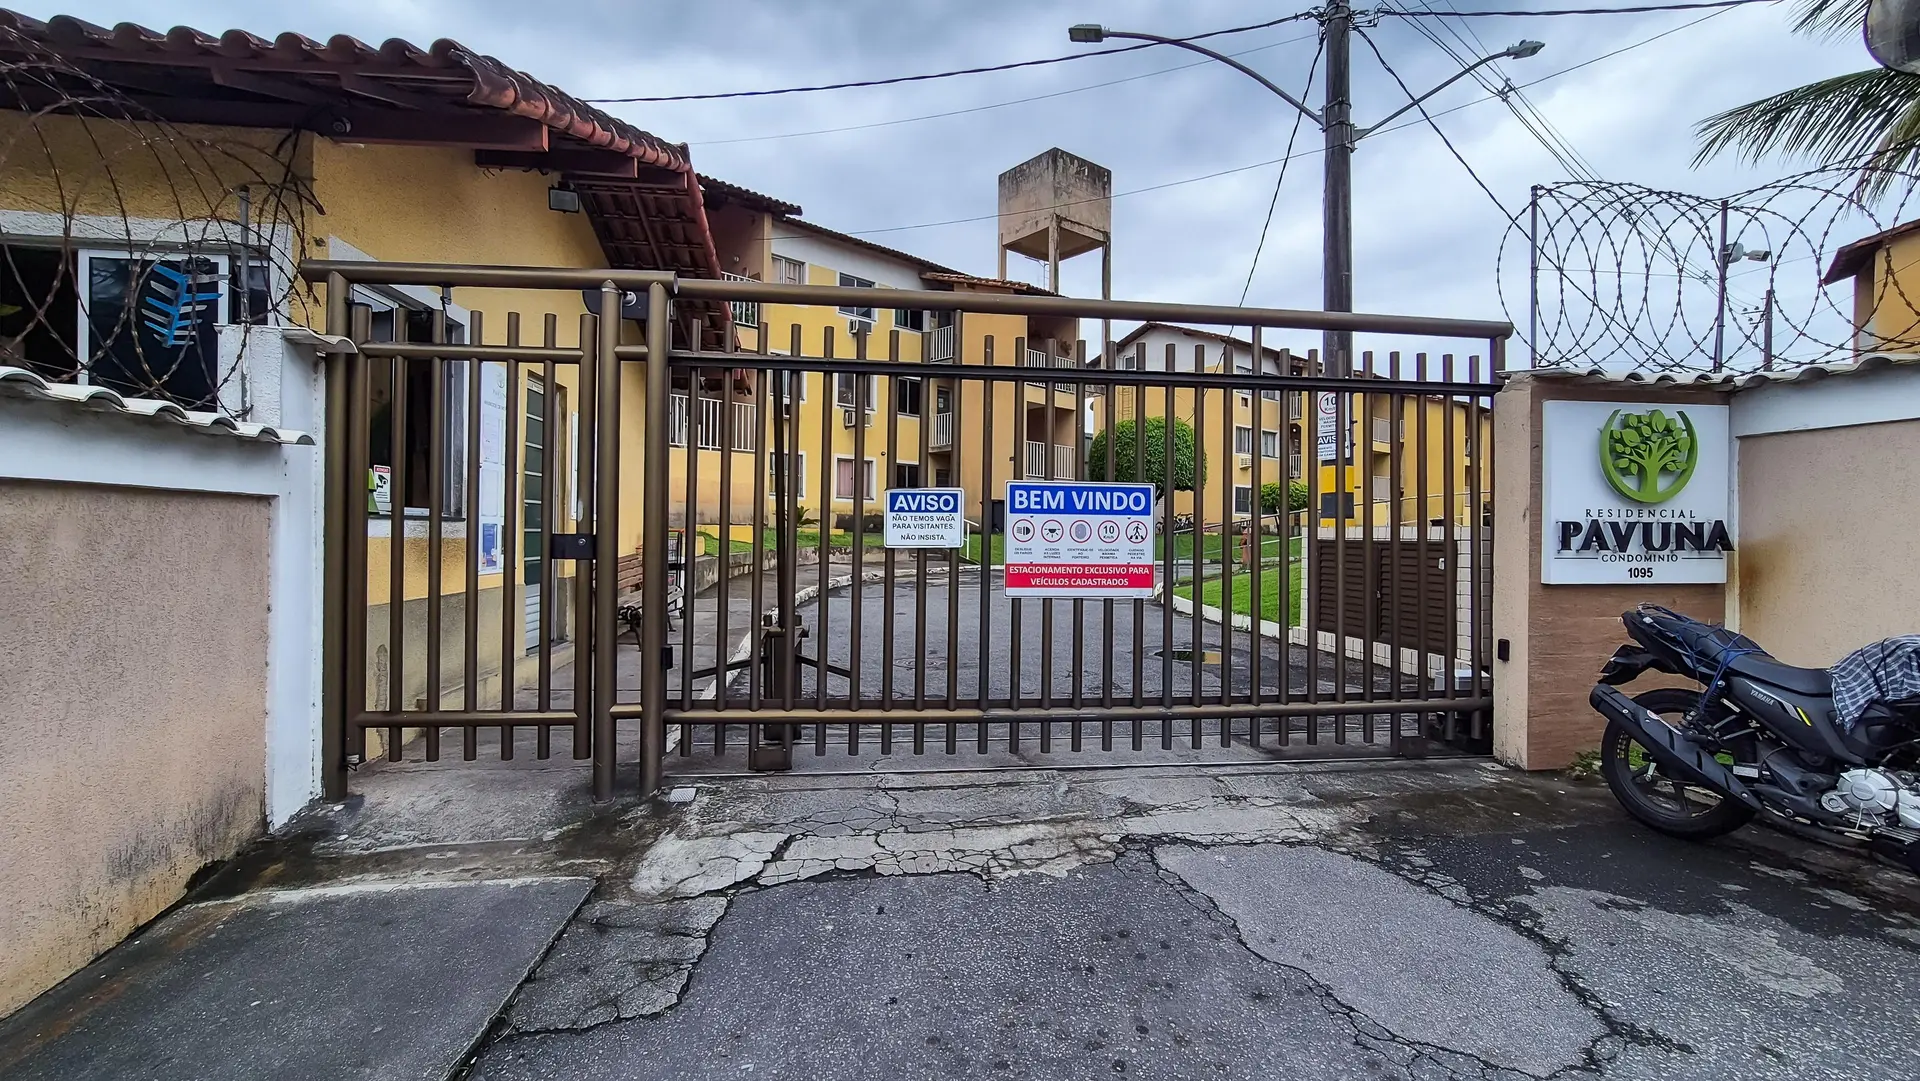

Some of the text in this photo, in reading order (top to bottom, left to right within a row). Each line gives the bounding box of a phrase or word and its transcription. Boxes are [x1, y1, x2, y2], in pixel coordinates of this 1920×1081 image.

[1318, 435, 1336, 444] AVIS
[893, 494, 955, 511] AVISO
[1014, 490, 1146, 511] BEM VINDO
[1585, 508, 1696, 519] RESIDENCIAL
[1103, 525, 1115, 534] 10
[1556, 519, 1736, 553] PAVUNA
[1601, 554, 1679, 563] CONDOMINIO
[1009, 566, 1150, 575] ESTACIONAMENTO EXCLUSIVO PARA
[1627, 567, 1654, 578] 1095
[1030, 577, 1129, 586] VEÍCULOS CADASTRADOS
[1750, 689, 1775, 706] YAMAHA
